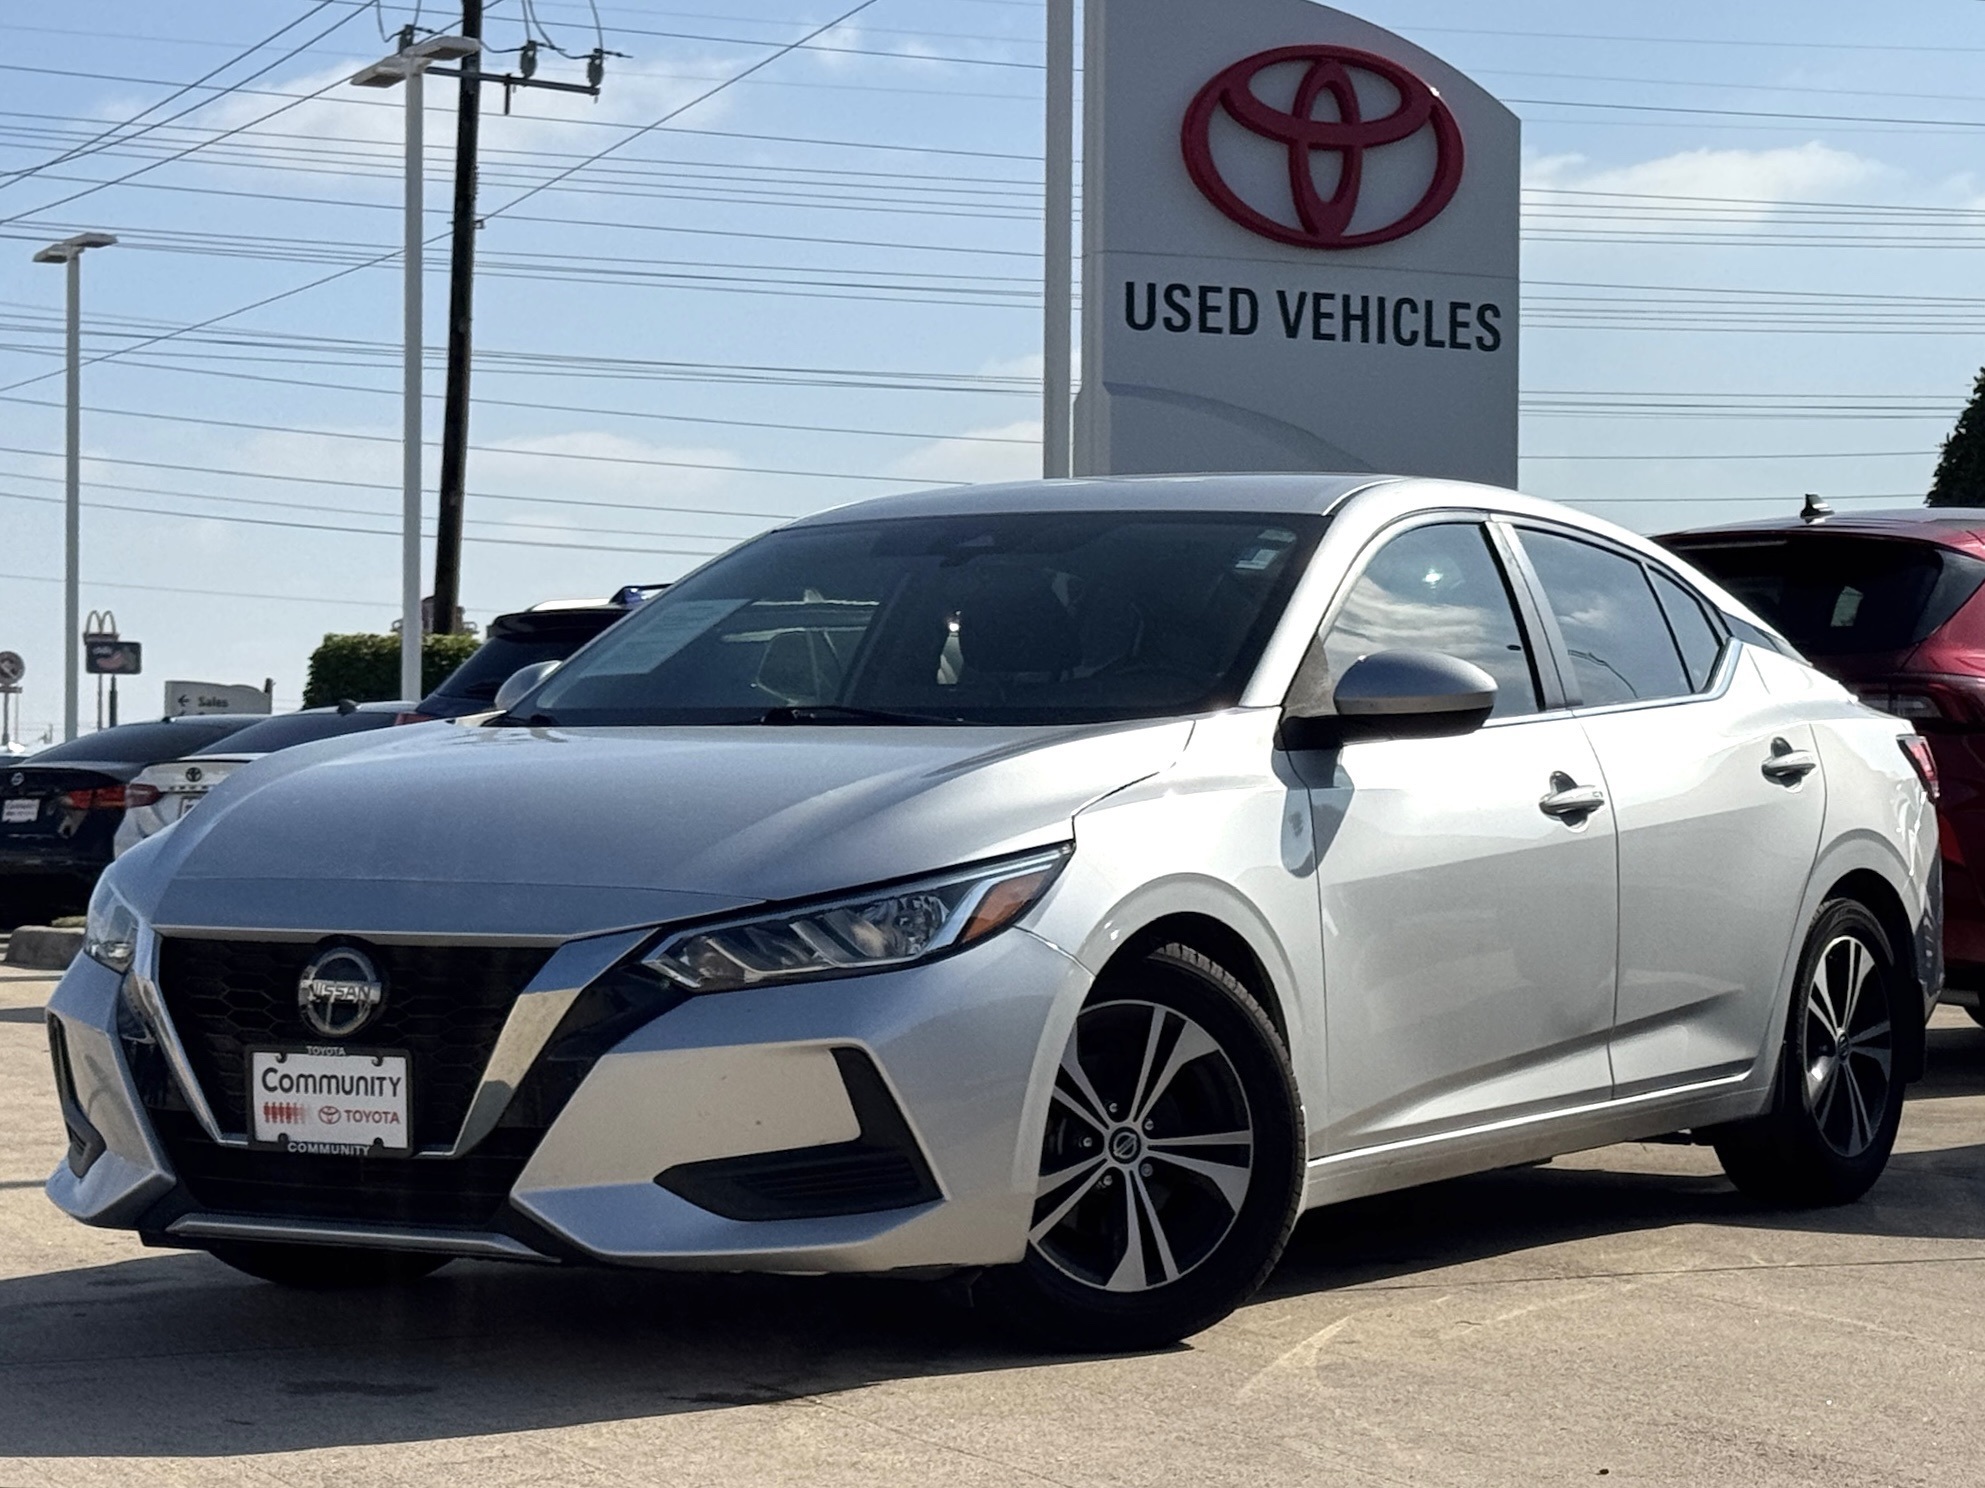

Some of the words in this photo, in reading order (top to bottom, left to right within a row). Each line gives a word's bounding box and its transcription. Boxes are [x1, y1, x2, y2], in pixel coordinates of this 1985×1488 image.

[1125, 281, 1259, 335] USED
[1276, 289, 1502, 352] VEHICLES
[198, 696, 229, 708] Sales
[308, 981, 372, 1001] NISSAN
[306, 1045, 347, 1056] TOYOTA
[344, 1109, 400, 1125] TOYOTA
[287, 1142, 371, 1156] COMMUNITY
